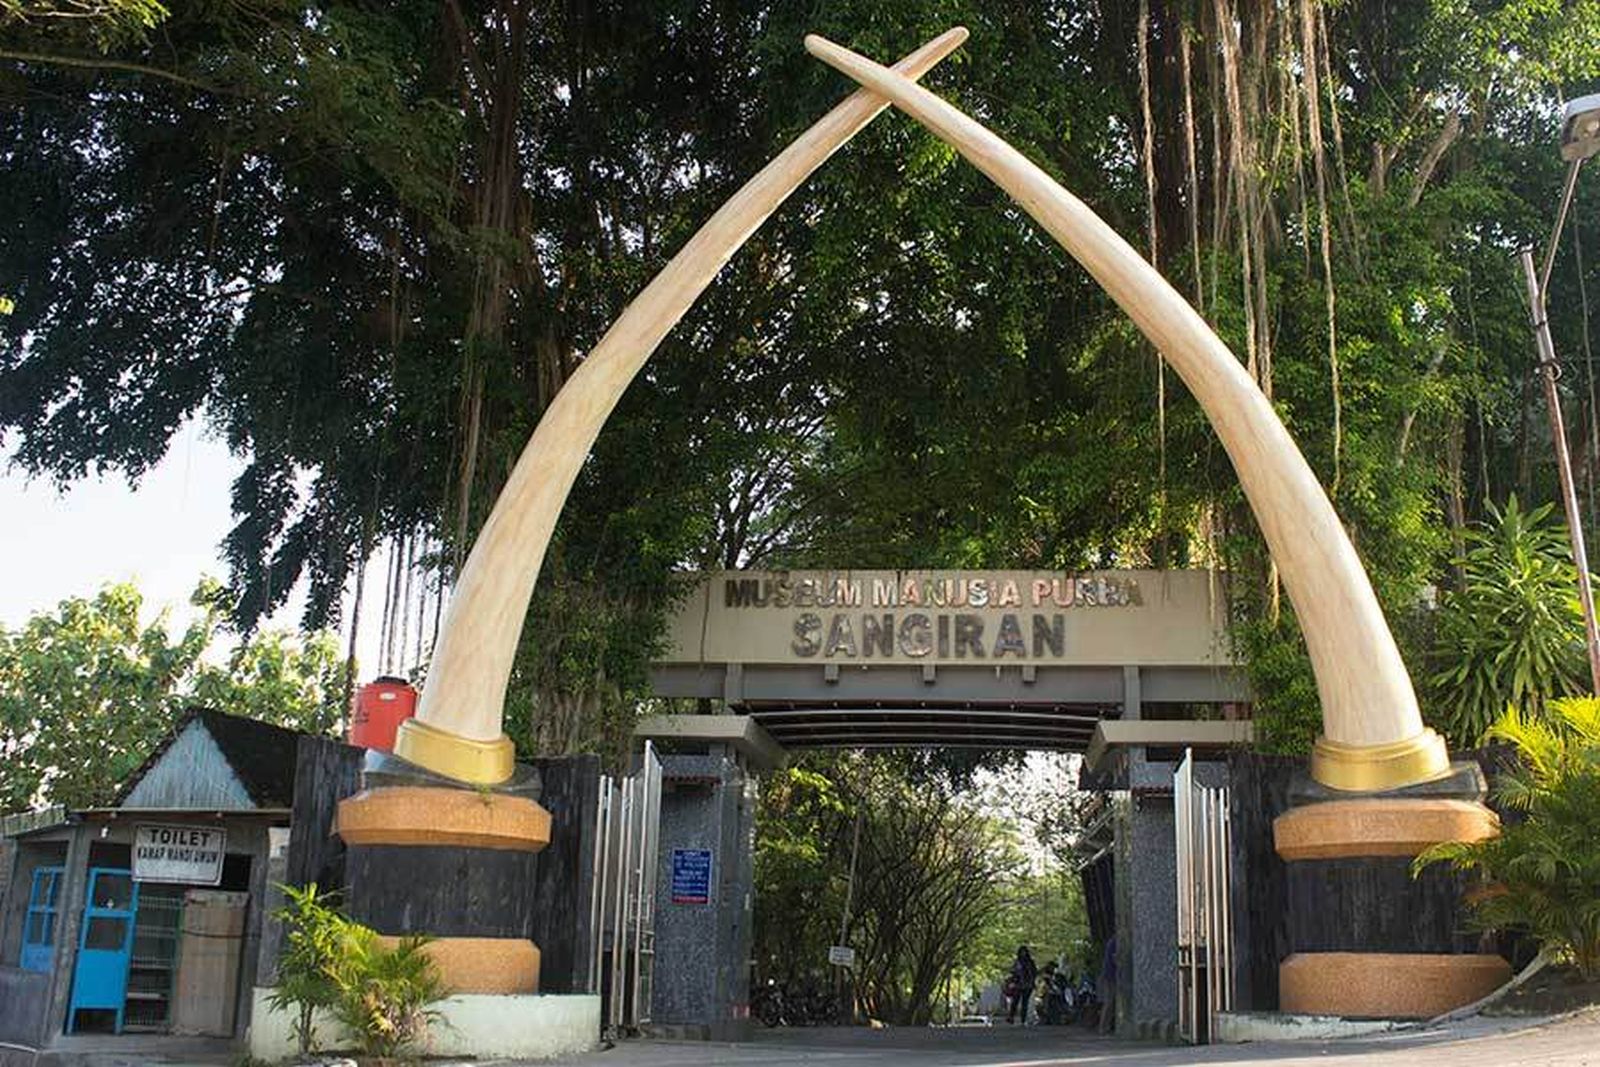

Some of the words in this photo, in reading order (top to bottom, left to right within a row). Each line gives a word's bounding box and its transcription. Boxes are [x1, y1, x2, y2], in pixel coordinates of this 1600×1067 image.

[725, 578, 862, 608] MUSEUM
[873, 577, 1022, 608] MANUSIA
[791, 613, 1065, 657] SANGIRAN
[150, 828, 210, 847] TOILET
